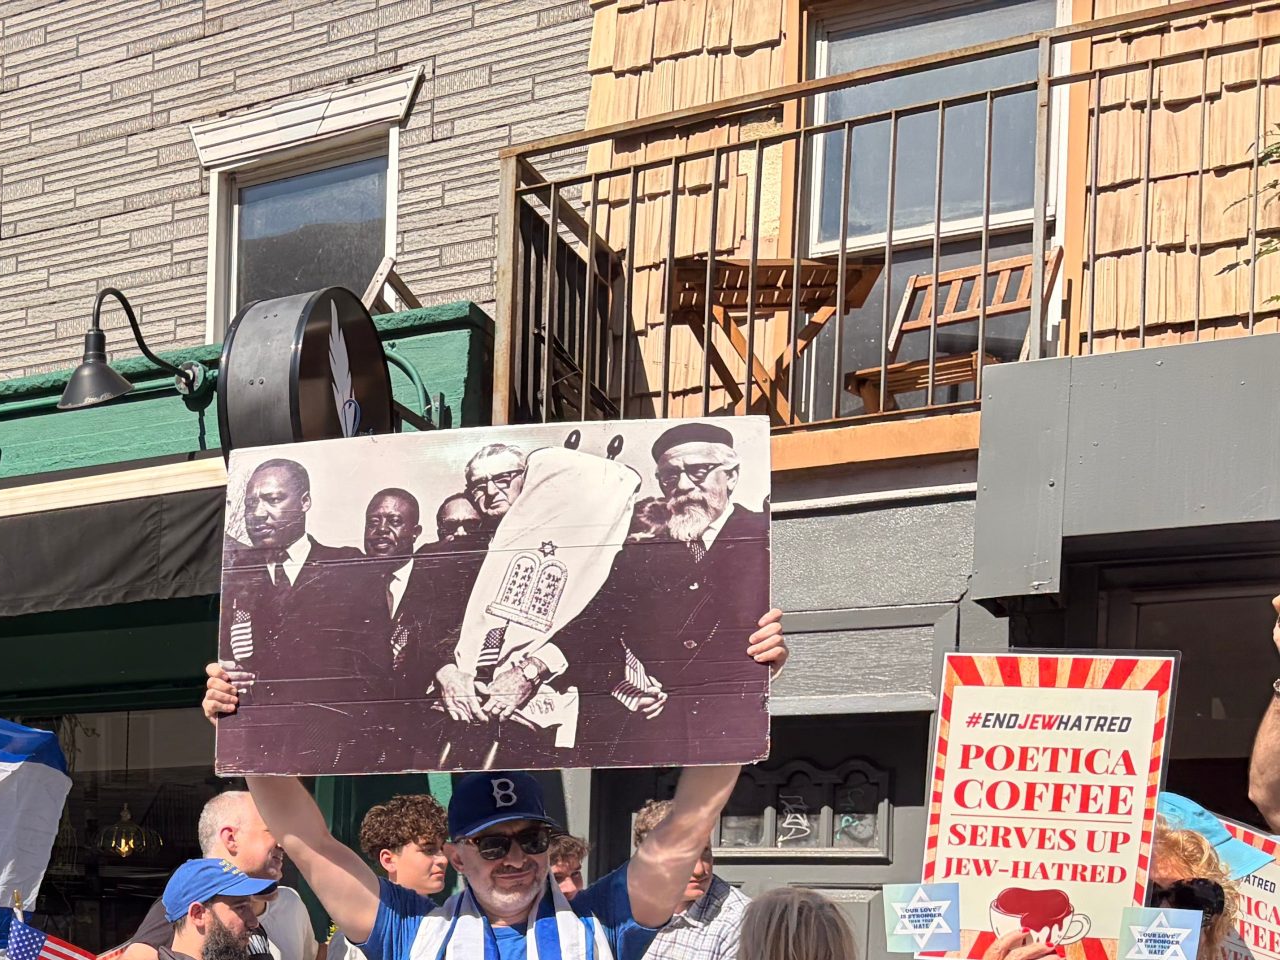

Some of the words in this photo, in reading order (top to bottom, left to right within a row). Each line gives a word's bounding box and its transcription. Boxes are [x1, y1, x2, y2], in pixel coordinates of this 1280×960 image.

[966, 712, 1133, 733] #ENDJEWHATRED
[958, 743, 1138, 777] POETICA
[491, 778, 517, 808] B
[953, 778, 1135, 816] COFFEE
[947, 822, 1078, 851] SERVES
[1086, 829, 1132, 854] UP
[941, 856, 1128, 885] JEW-HATRED
[1238, 893, 1280, 927] ICA
